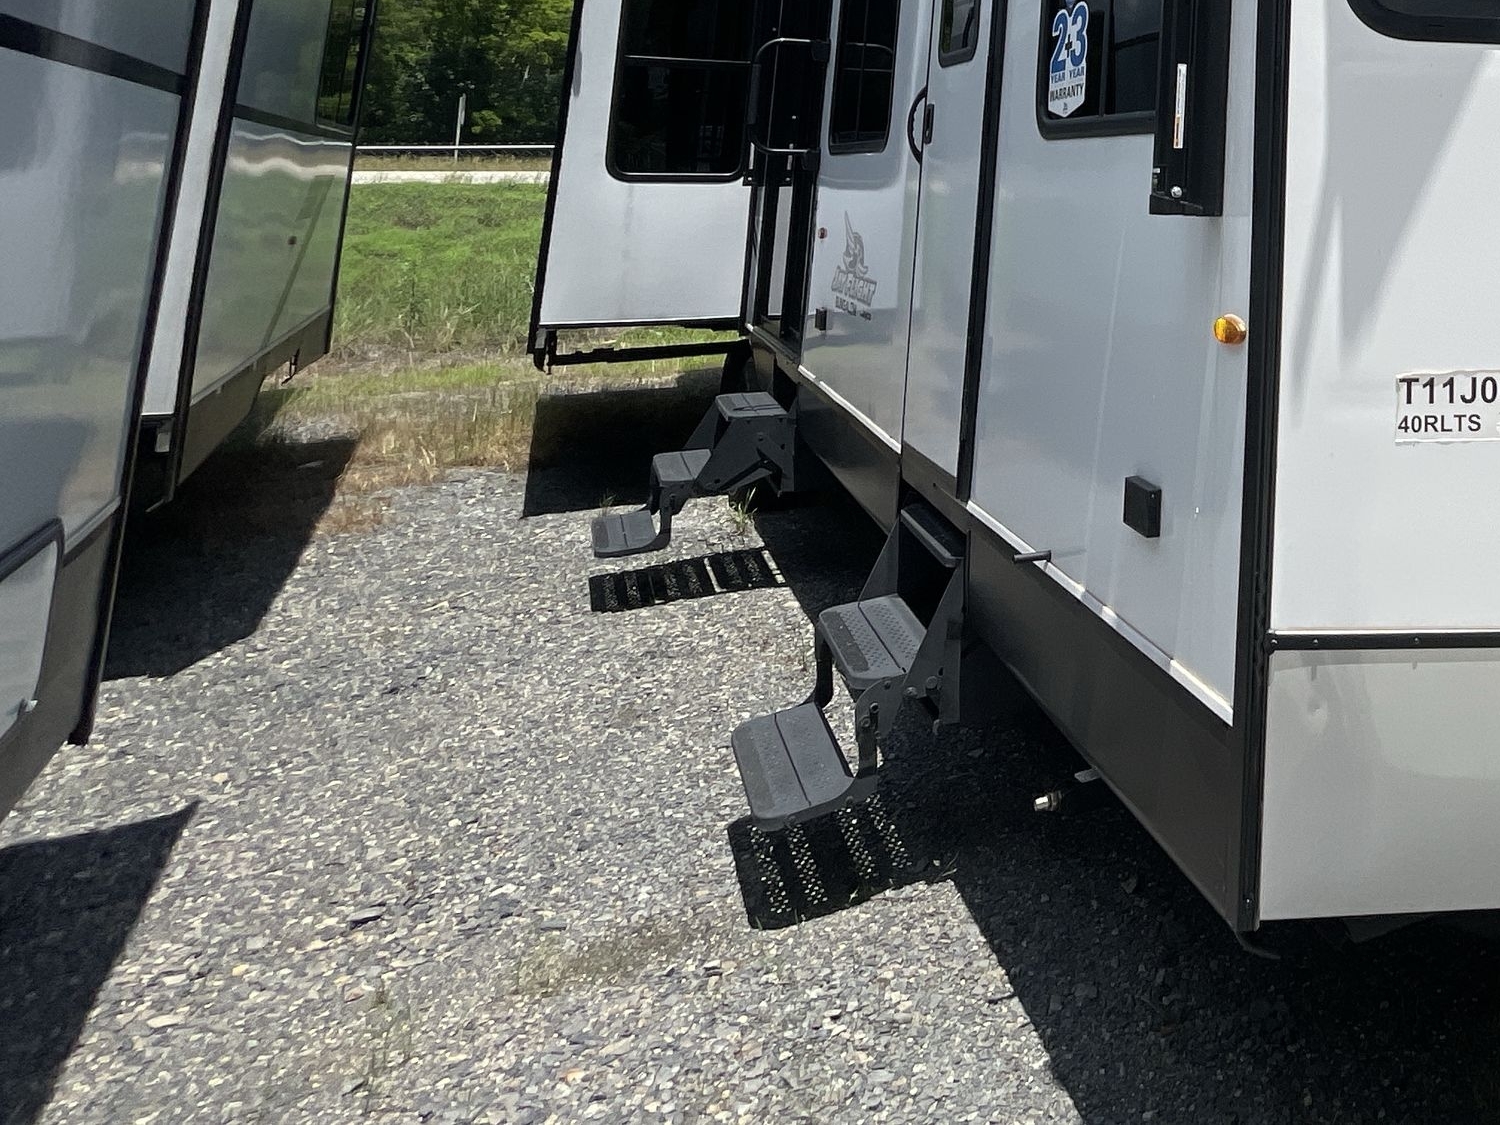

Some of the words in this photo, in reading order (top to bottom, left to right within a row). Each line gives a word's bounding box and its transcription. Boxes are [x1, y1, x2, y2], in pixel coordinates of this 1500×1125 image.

[1051, 72, 1066, 85] YEAR
[1069, 66, 1085, 80] YEAR
[1050, 83, 1084, 103] WARRANTY
[1398, 413, 1482, 434] 40RLTS
